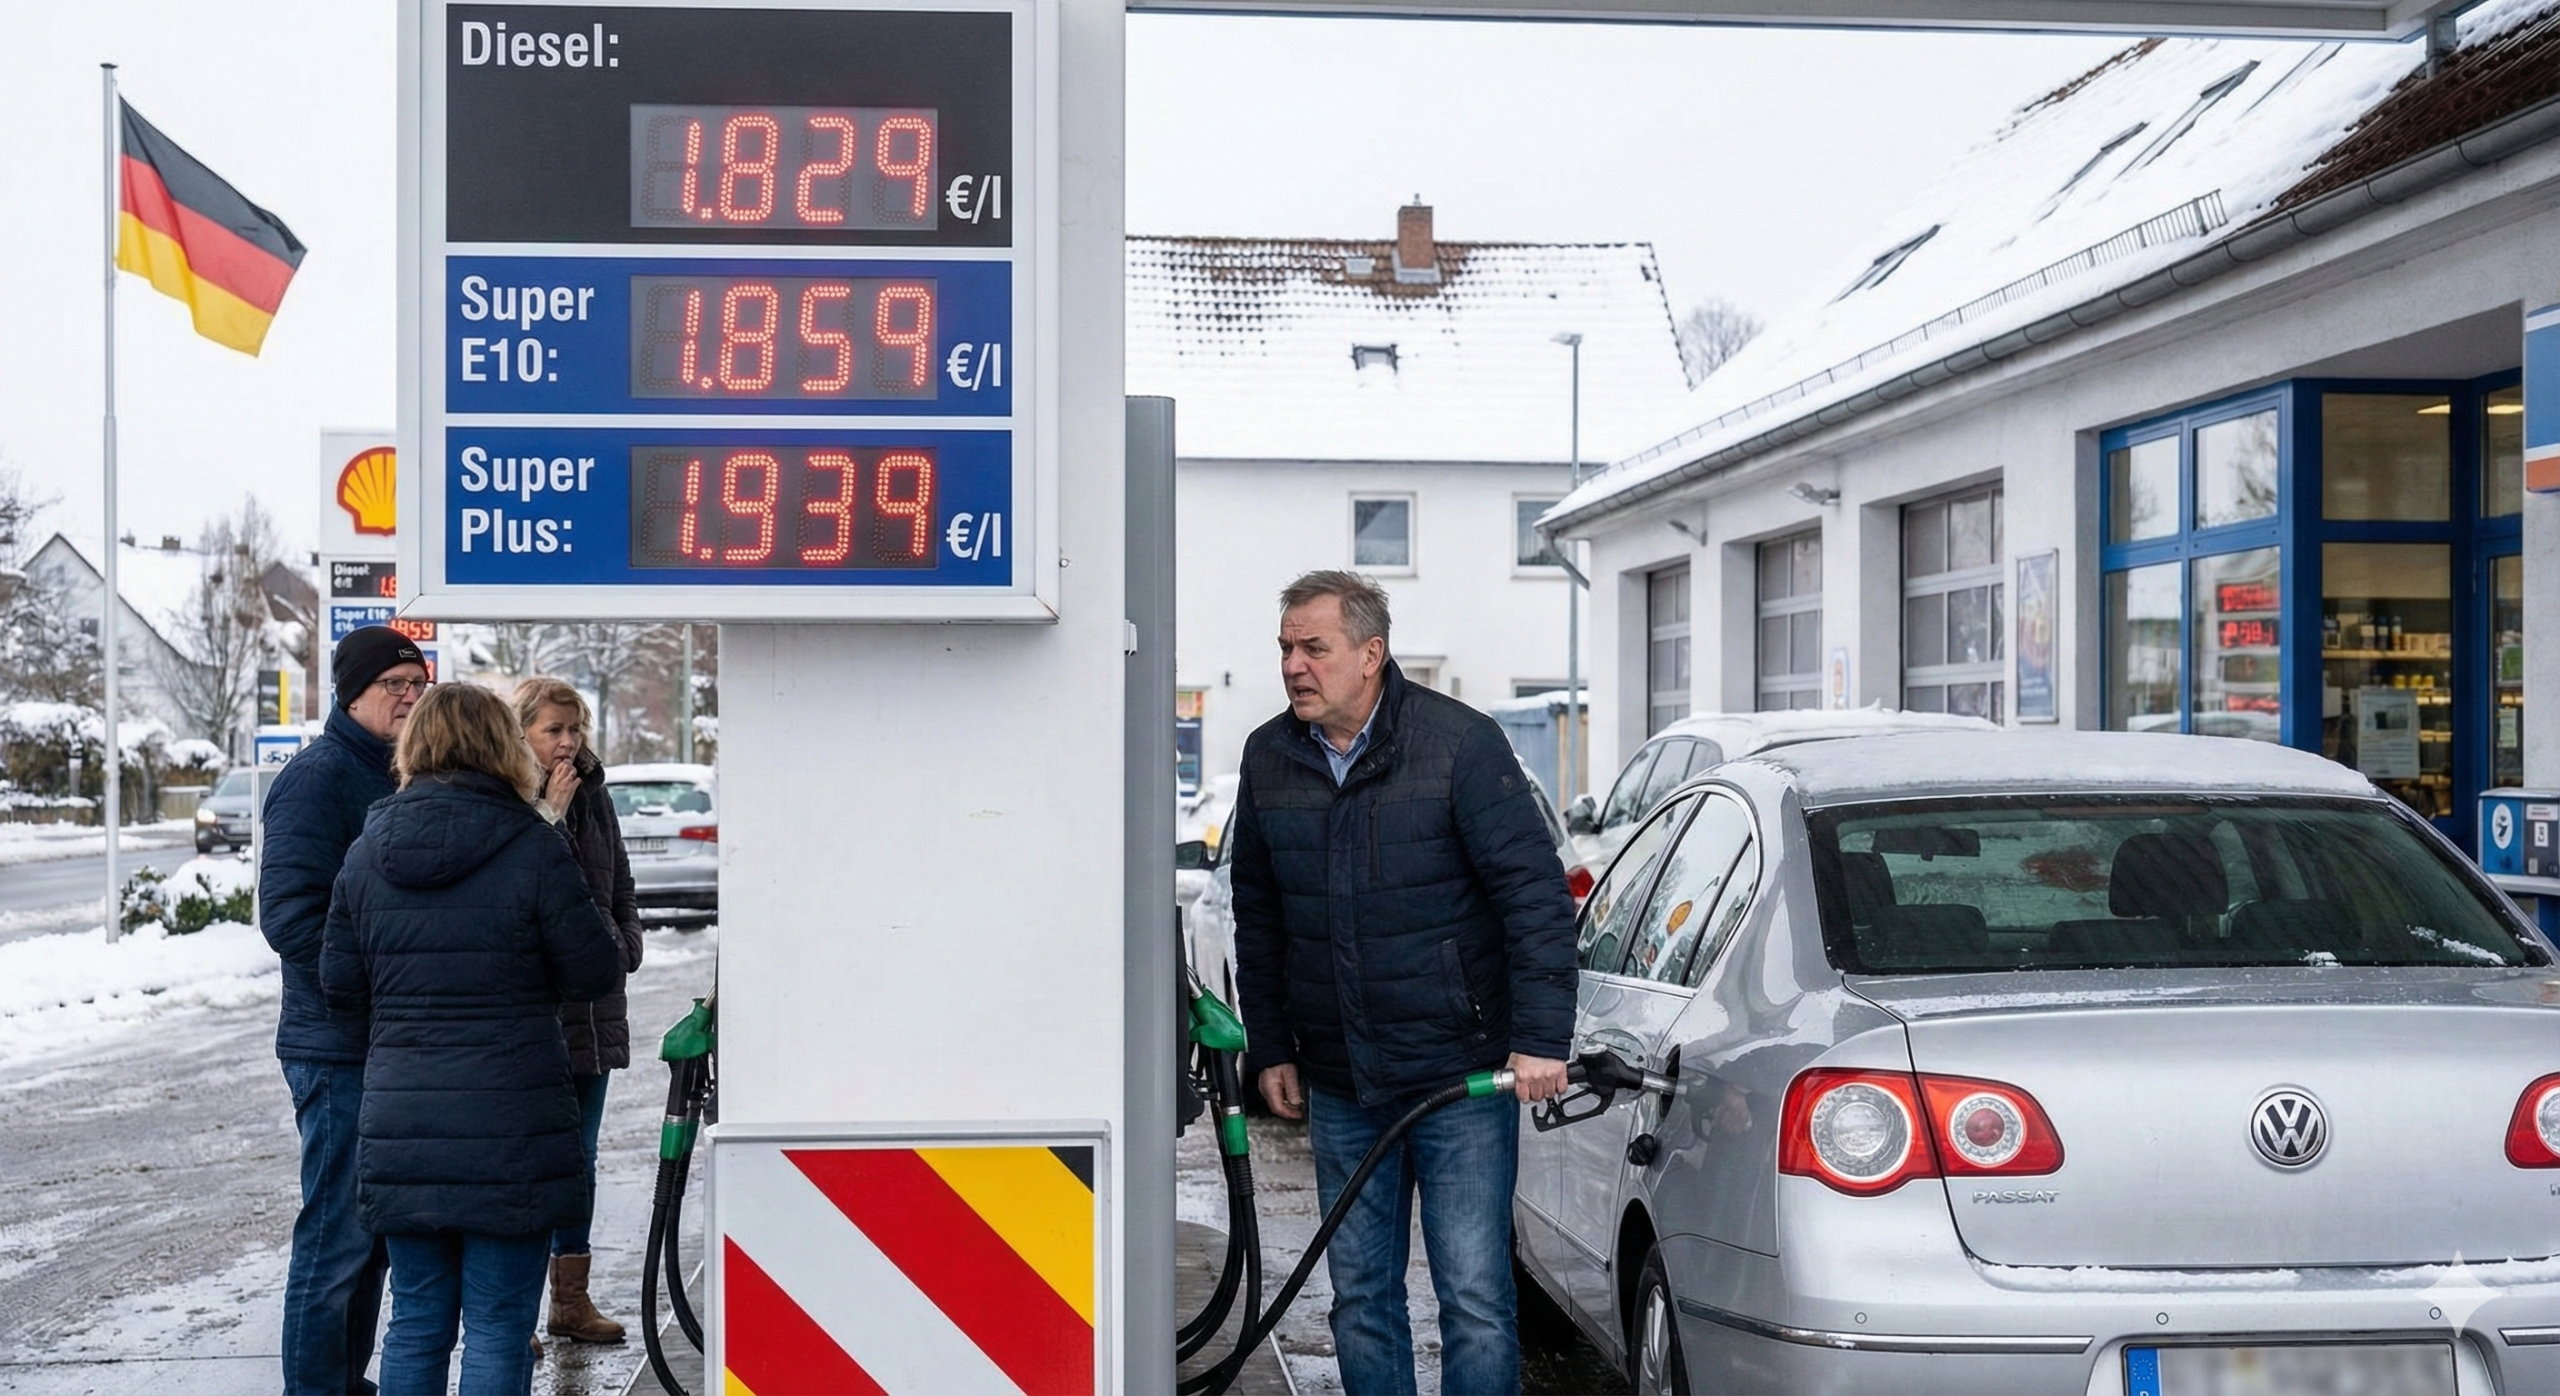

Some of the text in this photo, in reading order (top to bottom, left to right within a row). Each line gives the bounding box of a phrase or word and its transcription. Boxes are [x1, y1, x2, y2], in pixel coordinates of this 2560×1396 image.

[461, 21, 620, 68] Diesel:
[681, 115, 1002, 223] 1.829 €/l
[461, 275, 595, 330] Super
[461, 337, 558, 382] E10:
[681, 284, 1002, 391] 1.859 €/l
[461, 446, 595, 502] Super
[461, 508, 573, 553] Plus:
[681, 454, 1001, 561] 1.939 €/l
[1972, 1190, 2060, 1204] PASSAT
